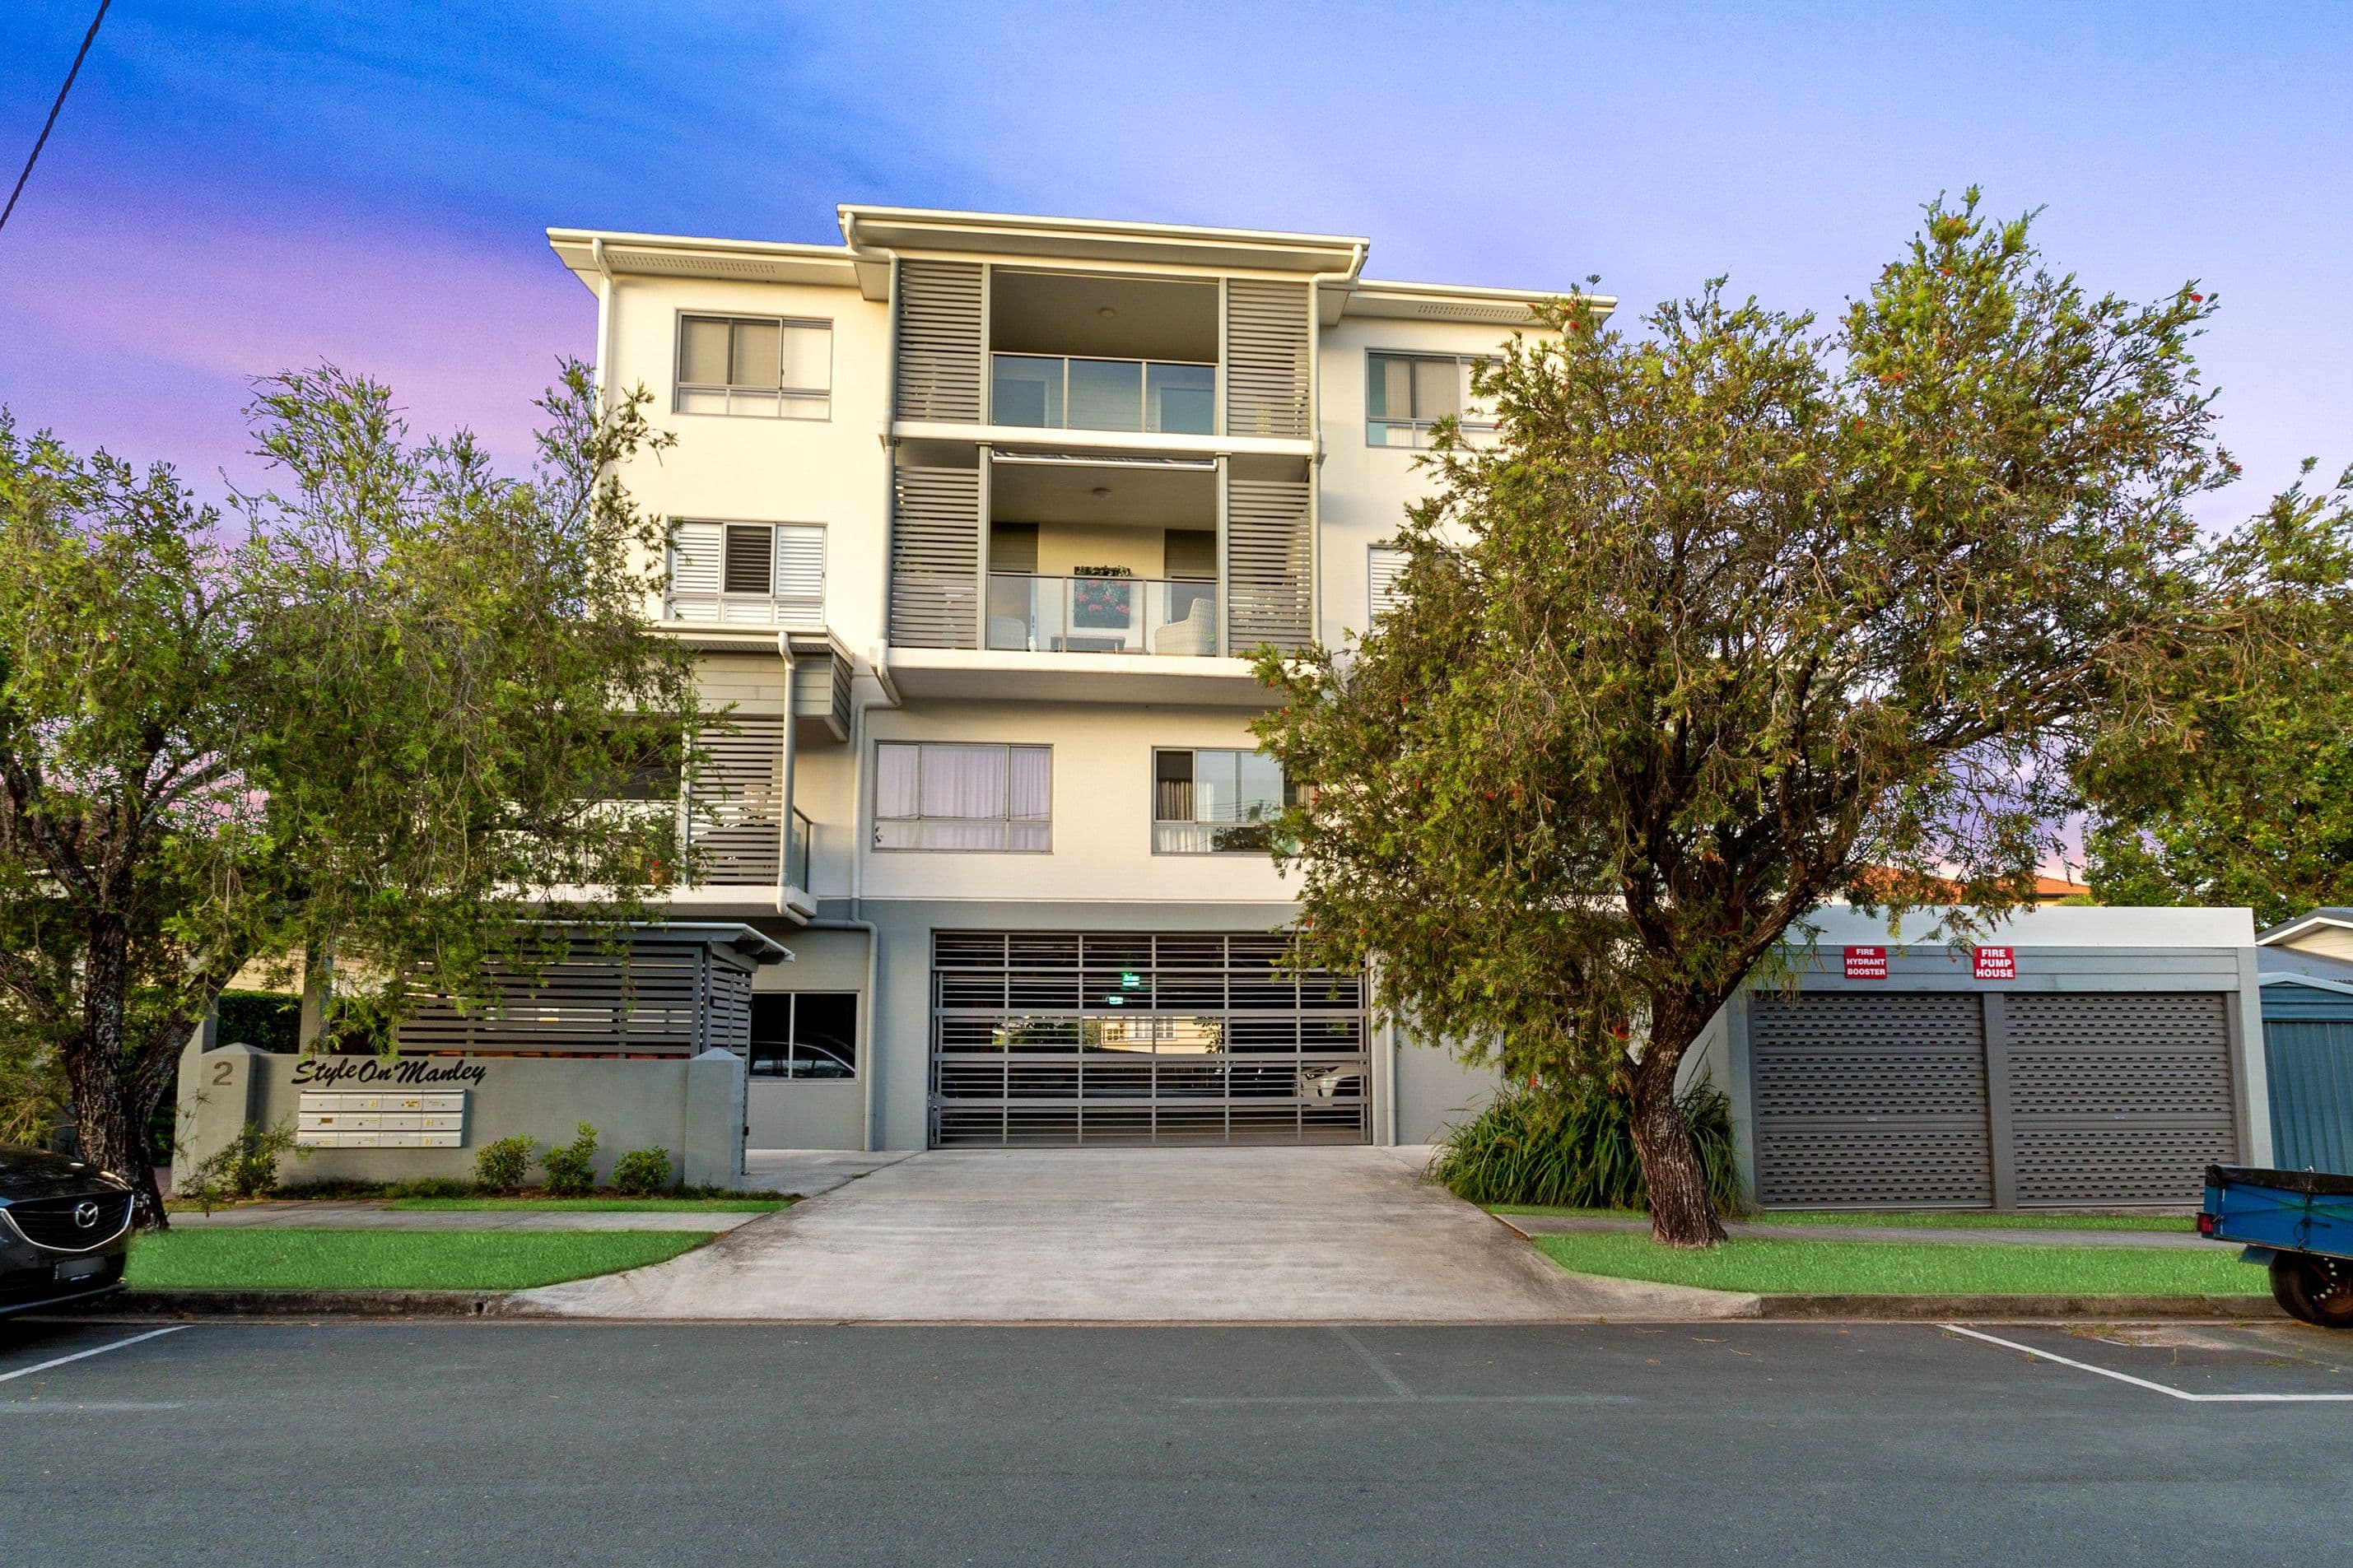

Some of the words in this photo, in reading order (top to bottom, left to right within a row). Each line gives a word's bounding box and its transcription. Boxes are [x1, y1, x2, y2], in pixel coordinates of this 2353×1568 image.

[1982, 949, 2006, 957] FIRE
[1980, 959, 2012, 968] PUMP
[1976, 968, 2014, 978] HOUSE
[212, 1061, 234, 1086] 2
[291, 1058, 357, 1086] Style
[358, 1059, 393, 1083] On
[394, 1059, 487, 1086] Manley
